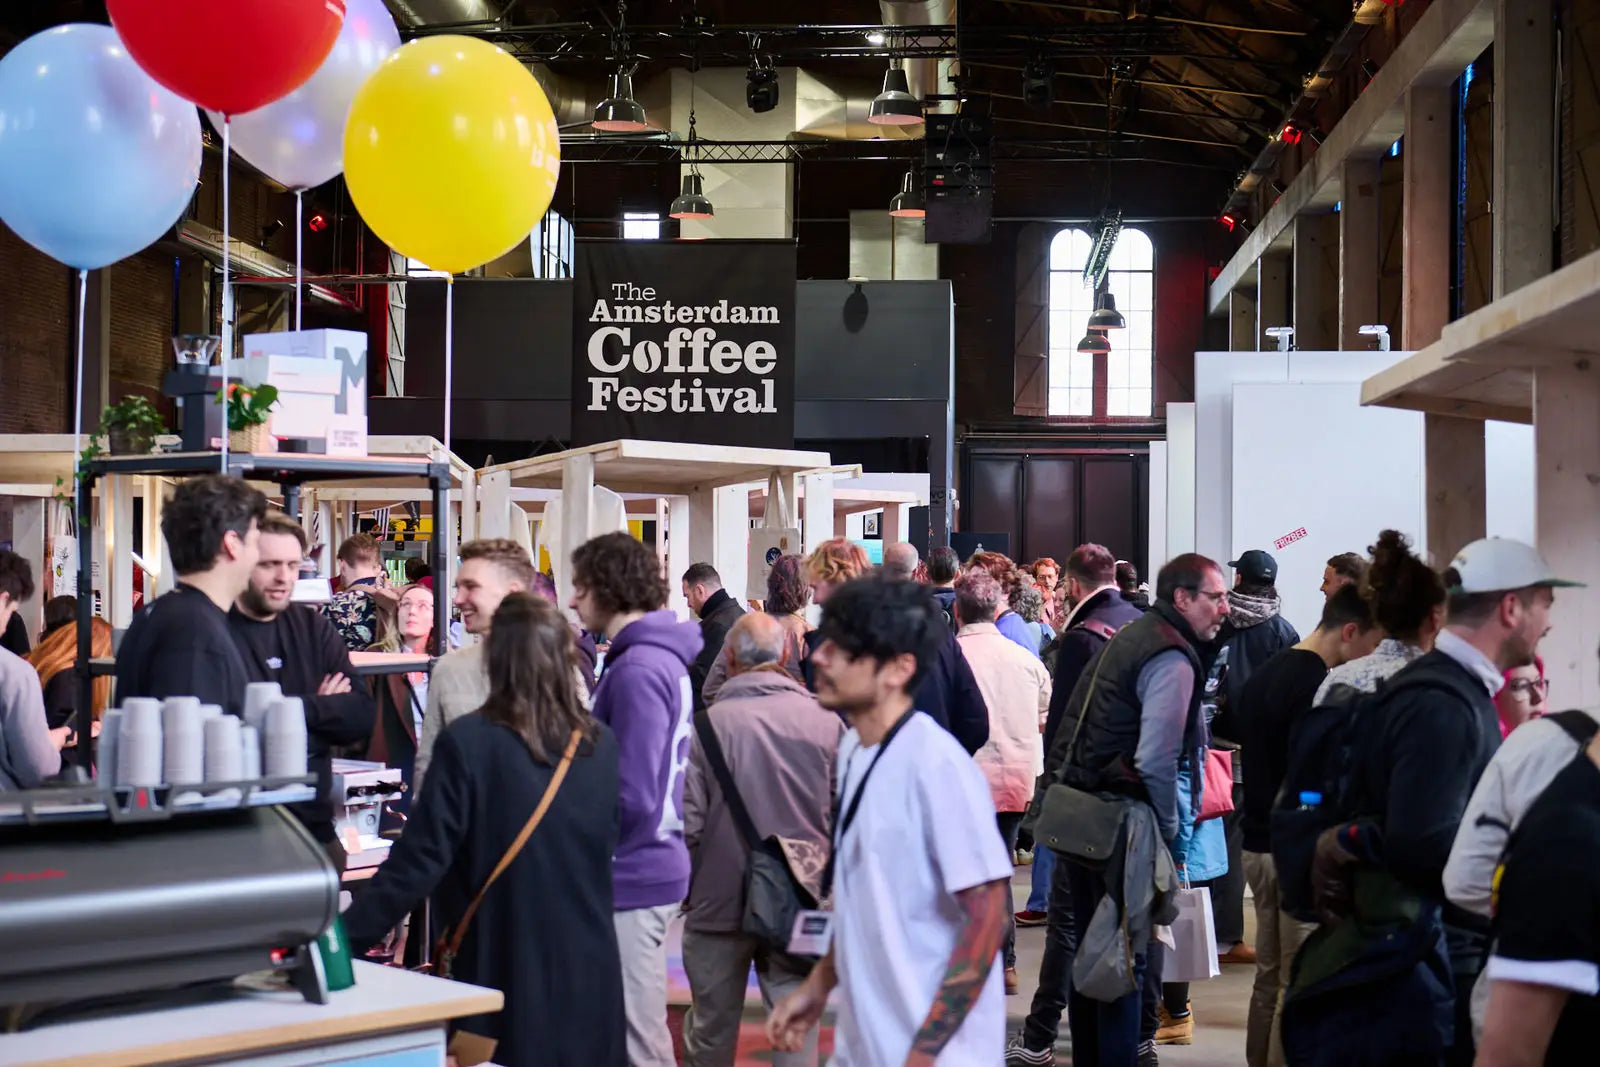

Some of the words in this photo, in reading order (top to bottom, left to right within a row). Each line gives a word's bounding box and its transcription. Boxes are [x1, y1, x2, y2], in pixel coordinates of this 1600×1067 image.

[611, 282, 656, 301] The
[588, 298, 780, 324] Amsterdam
[587, 326, 777, 375] Coffee
[587, 377, 778, 414] Festival
[1274, 527, 1308, 550] FRIZBEE
